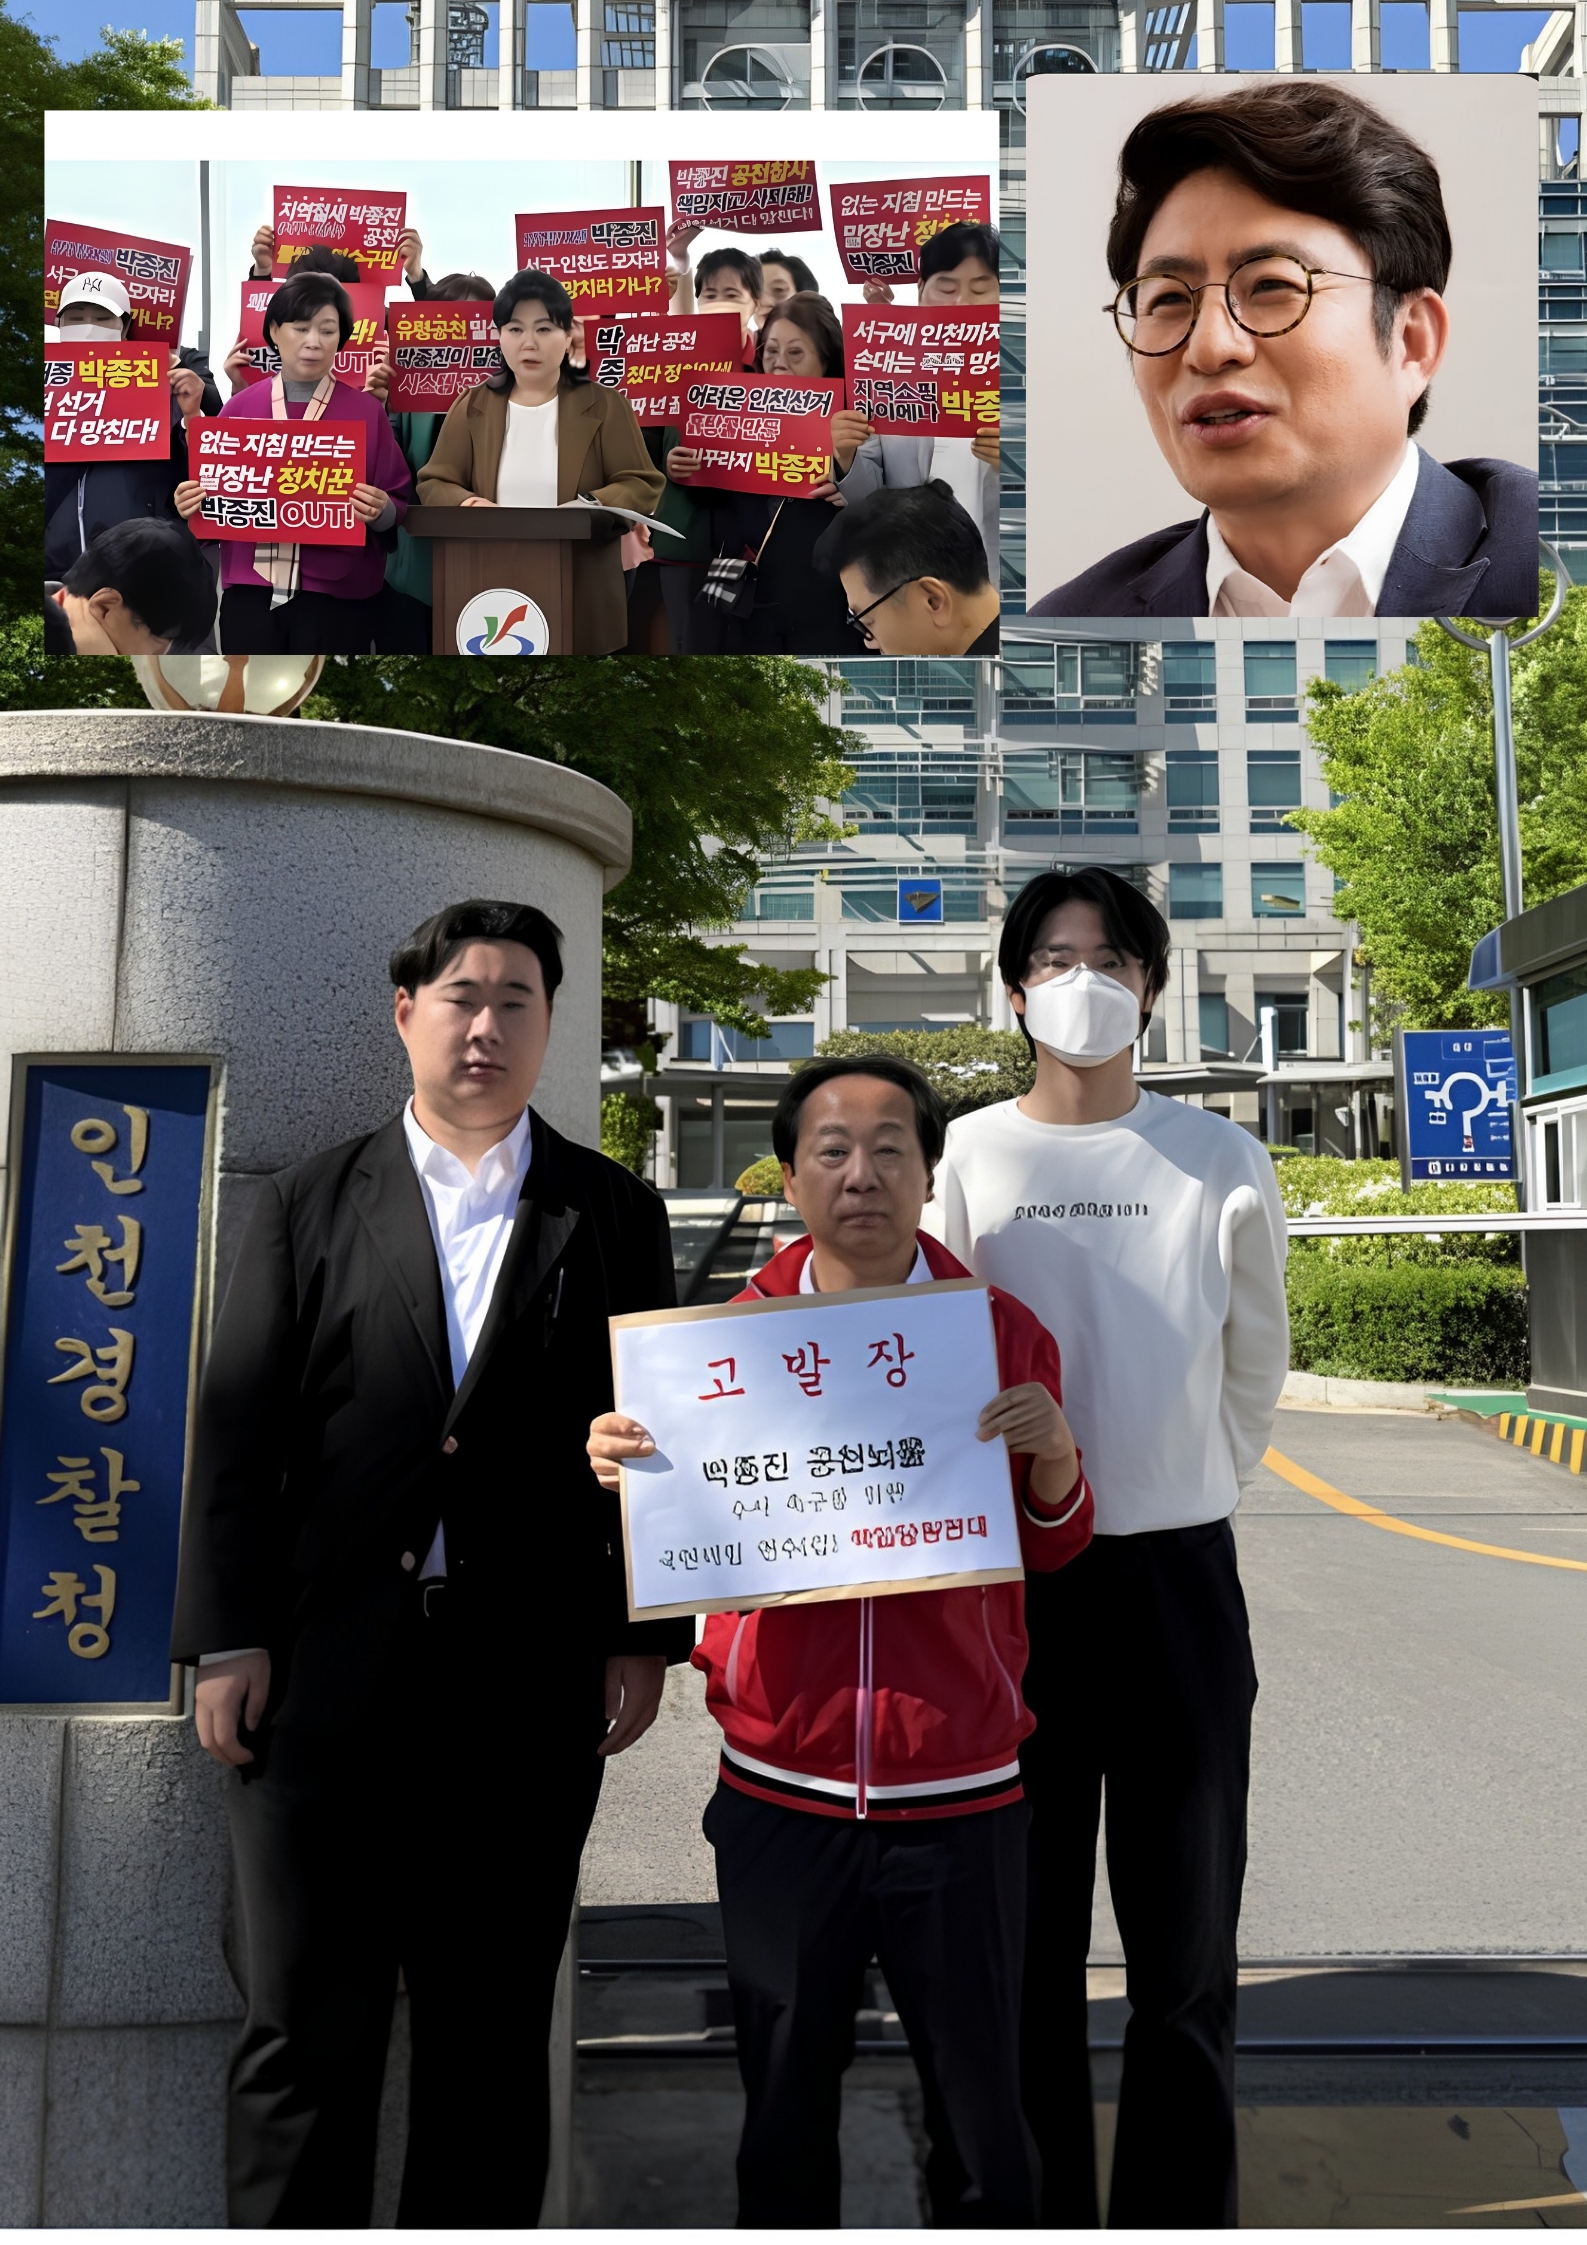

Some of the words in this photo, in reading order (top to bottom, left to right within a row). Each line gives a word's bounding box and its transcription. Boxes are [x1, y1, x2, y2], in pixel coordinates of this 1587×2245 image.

[677, 165, 728, 189] 박종진
[349, 204, 402, 226] 박종진
[841, 194, 879, 216] 없는
[881, 190, 923, 214] 지침
[925, 188, 983, 212] 만드는
[591, 219, 659, 248] 박종진
[115, 247, 181, 286] 박종진
[611, 250, 660, 270] 모자라
[847, 250, 918, 277] 박종진
[128, 281, 176, 308] 모자라
[597, 324, 626, 356] 박
[853, 320, 918, 346] 서구에
[78, 358, 160, 389] 박종진
[596, 357, 626, 388] 종
[853, 348, 916, 374] 손대는
[57, 390, 107, 417] 선거
[687, 383, 747, 411] 어려운
[747, 386, 834, 418] 인천선거
[50, 419, 78, 446] 다
[80, 417, 160, 446] 망친다!
[200, 430, 241, 456] 없는
[242, 432, 289, 459] 지침
[290, 433, 356, 459] 만드는
[199, 463, 275, 494] 말장난
[276, 466, 354, 495] 정치꾼
[755, 450, 831, 485] 박종진
[201, 495, 279, 530] 박종진
[280, 501, 356, 530] OUT!
[32, 1103, 151, 1660] 인천경찰청
